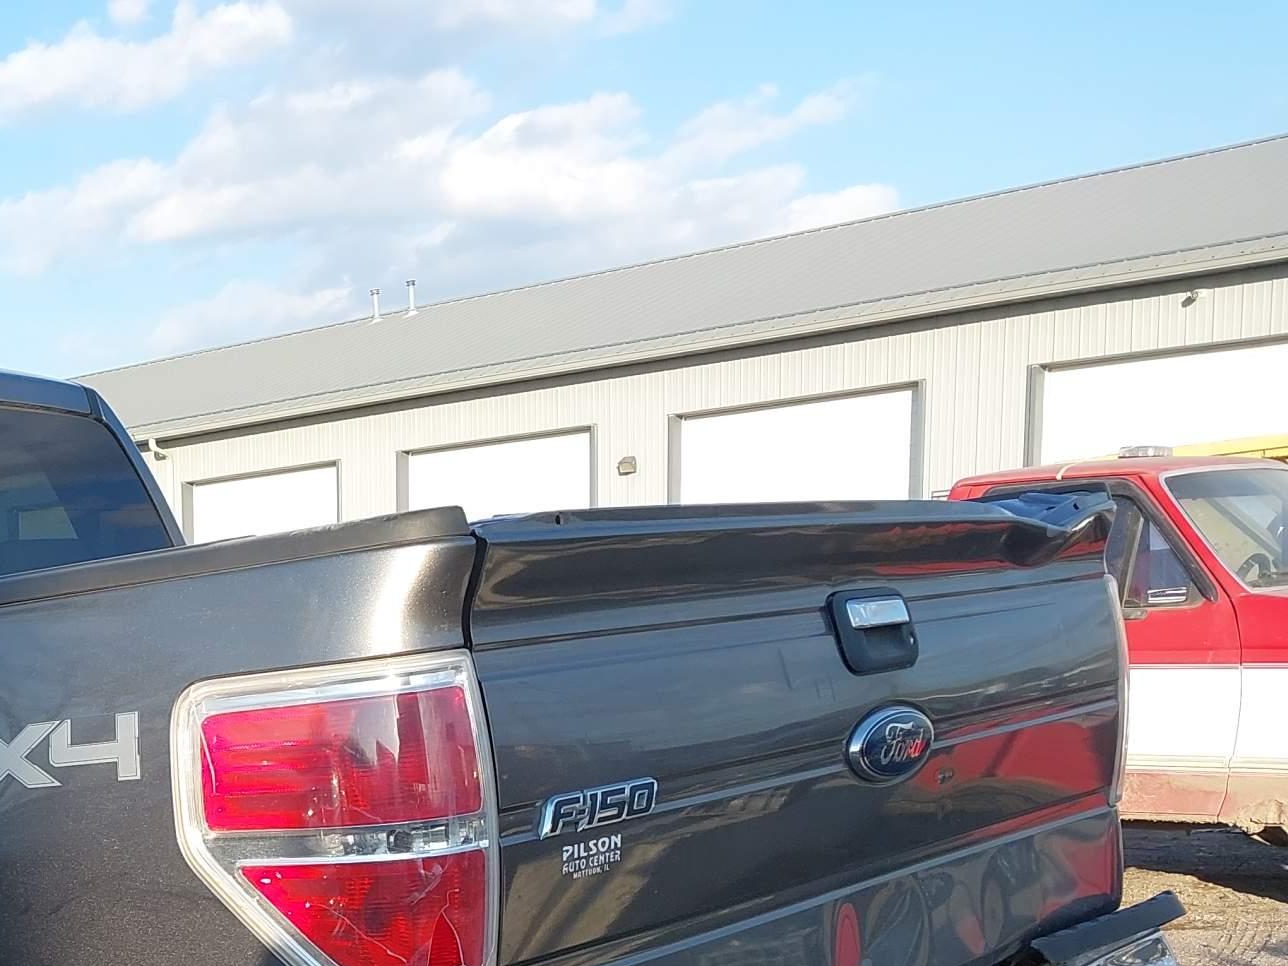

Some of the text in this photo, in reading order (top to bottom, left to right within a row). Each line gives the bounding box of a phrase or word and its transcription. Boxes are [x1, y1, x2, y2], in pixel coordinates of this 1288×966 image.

[880, 721, 924, 765] Ford
[539, 777, 658, 840] F-150
[562, 833, 622, 861] PILSON
[562, 850, 621, 875] AUTO CENTER
